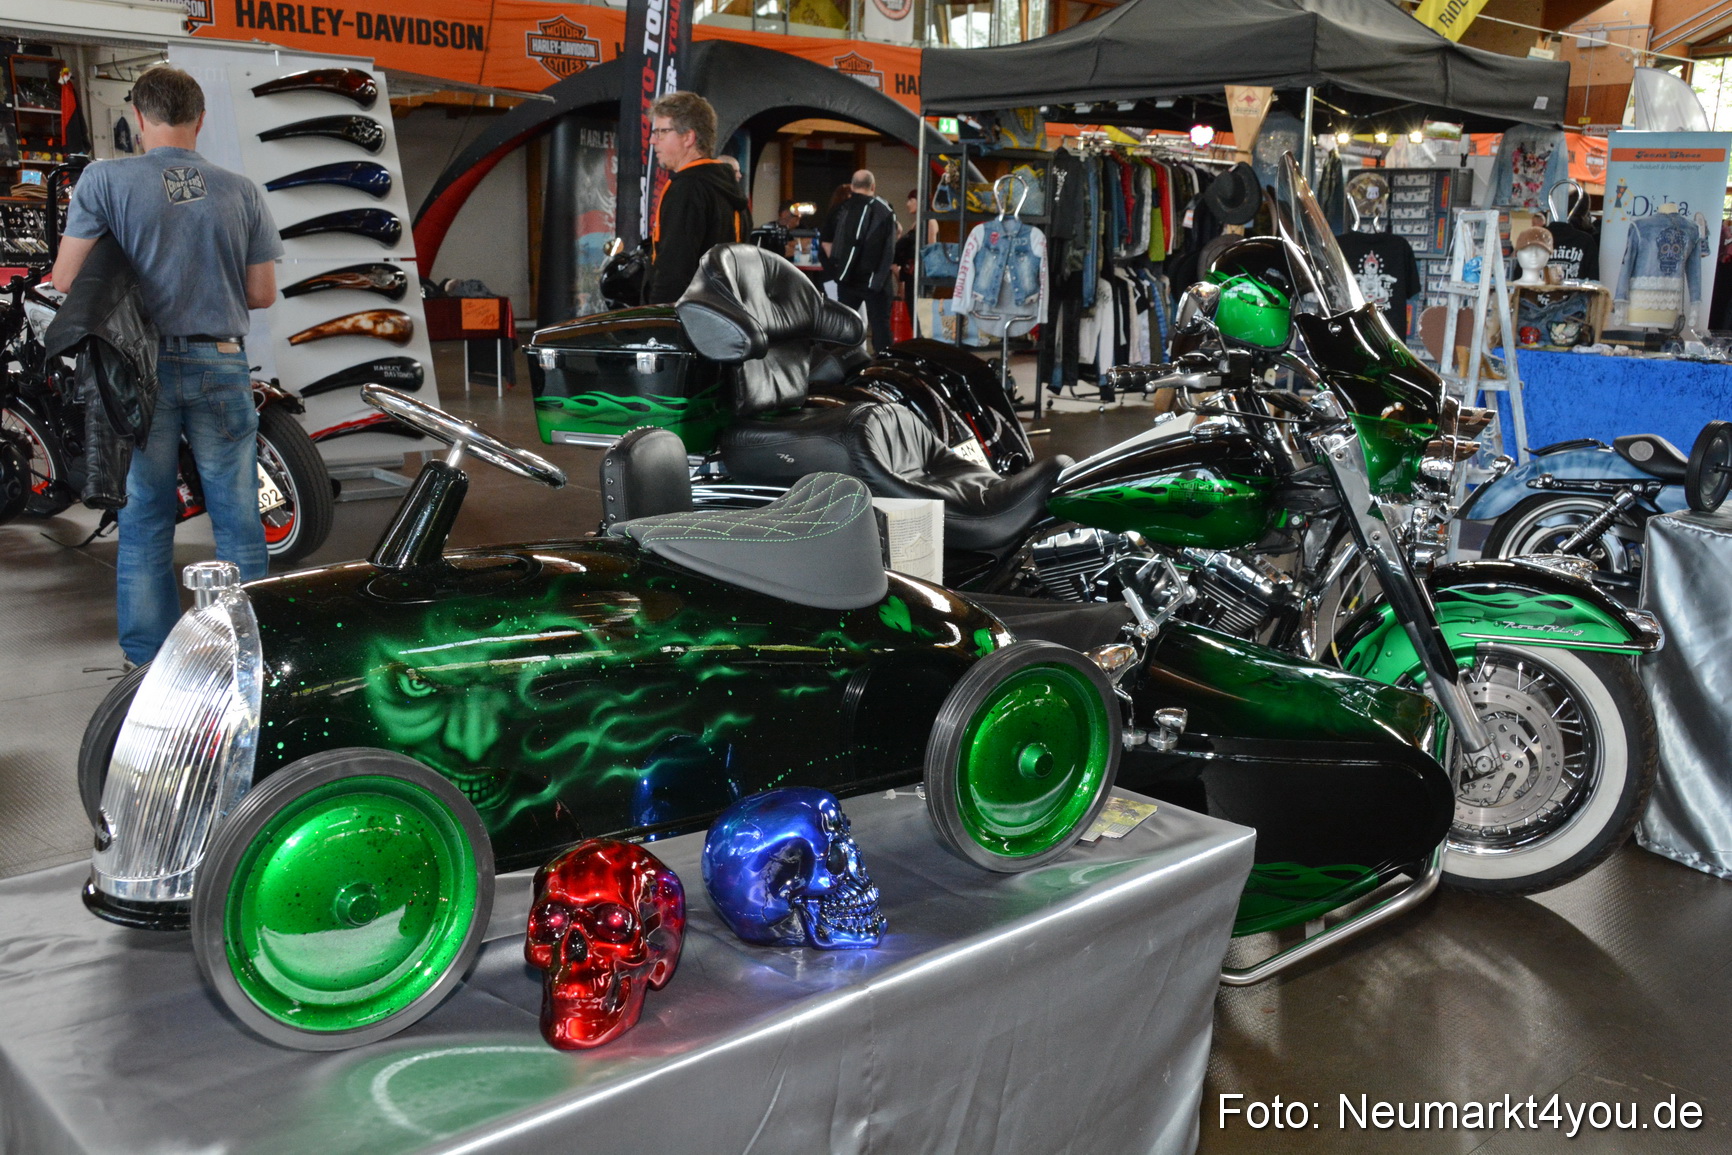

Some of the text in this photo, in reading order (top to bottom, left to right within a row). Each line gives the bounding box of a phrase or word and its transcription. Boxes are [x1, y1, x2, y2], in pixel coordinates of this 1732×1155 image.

[235, 0, 484, 51] HARLEY-DAVIDSON
[548, 22, 583, 39] MOTOR
[531, 38, 596, 58] HARLEY-DAVIDSON
[547, 57, 586, 76] CYCLES
